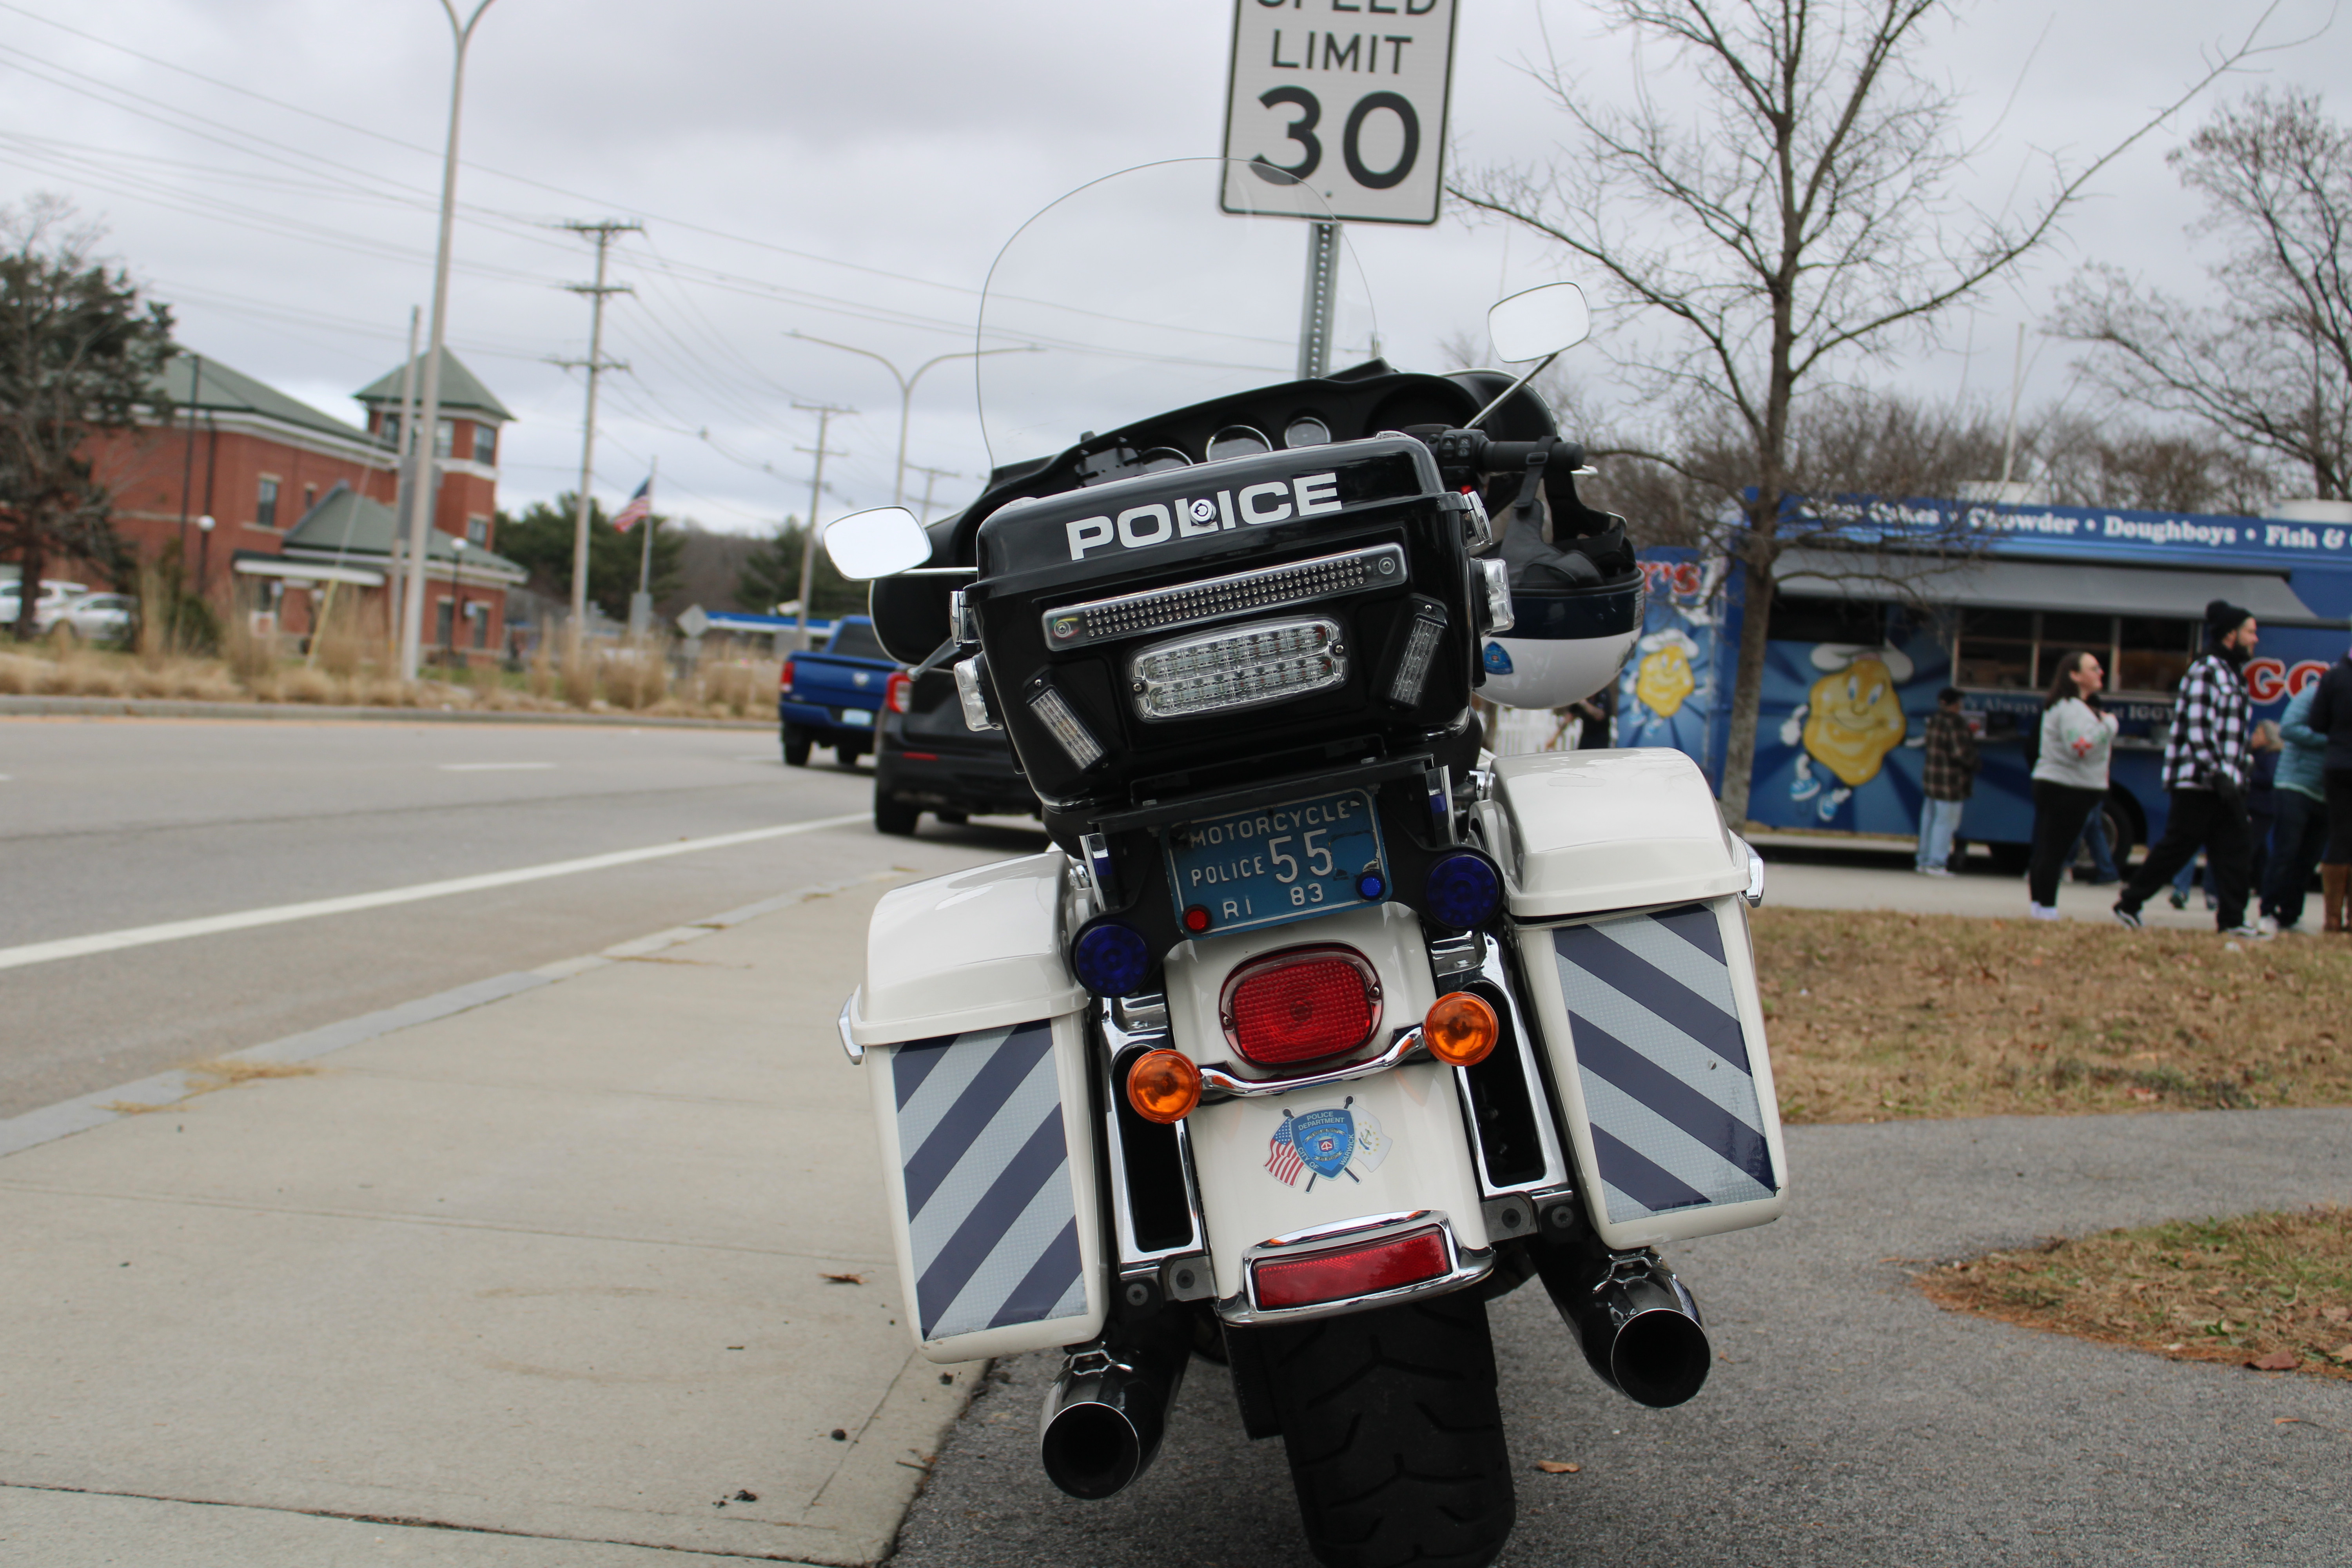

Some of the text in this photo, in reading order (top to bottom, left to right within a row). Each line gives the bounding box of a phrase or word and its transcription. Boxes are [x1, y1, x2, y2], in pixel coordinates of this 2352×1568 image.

[1271, 29, 1413, 74] LIMIT
[1248, 85, 1420, 189] 30
[1066, 473, 1342, 561] POLICE
[1967, 507, 2079, 534] Chowder
[2104, 515, 2237, 546] Doughboys
[2264, 524, 2317, 549] Fish
[2322, 527, 2346, 550] &
[1189, 800, 1350, 848] MOTORCYCLE
[1191, 828, 1333, 887] POLICE 55
[1223, 883, 1323, 919] RI 83
[1298, 1117, 1345, 1131] DEPARTMENT
[1307, 1112, 1334, 1121] POLICE
[1298, 1147, 1310, 1161] CITY
[1339, 1134, 1354, 1165] WARWICK
